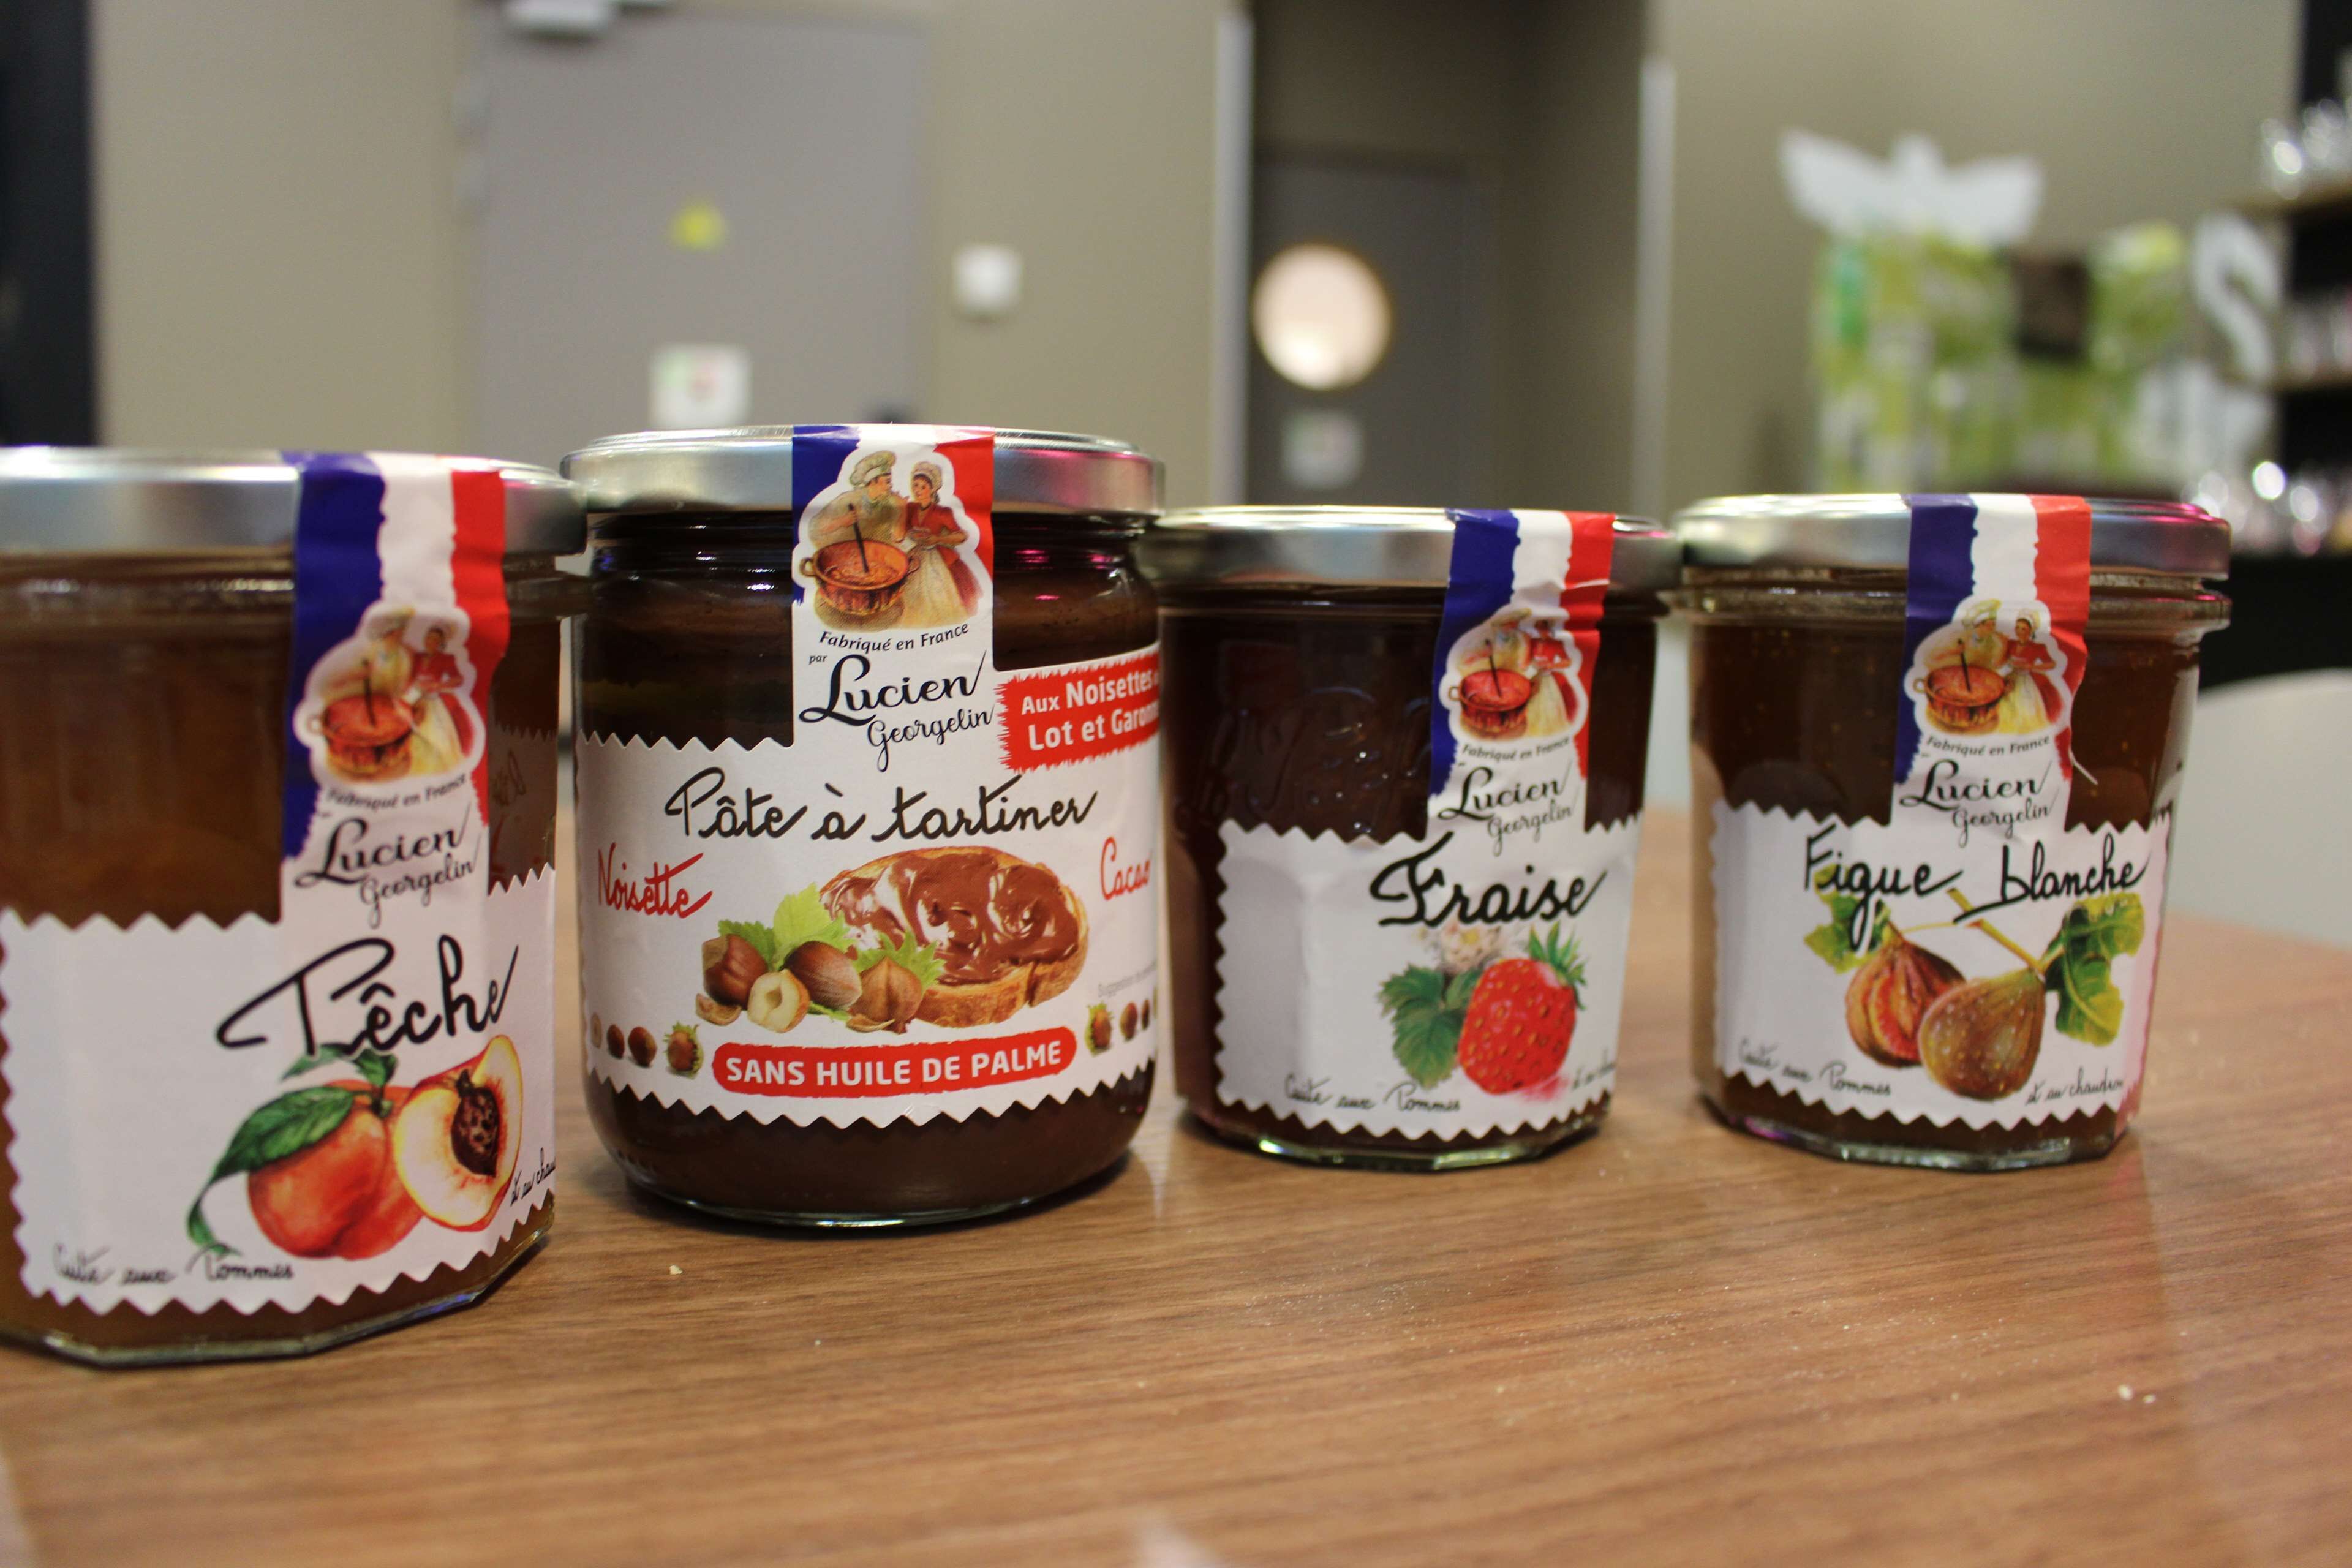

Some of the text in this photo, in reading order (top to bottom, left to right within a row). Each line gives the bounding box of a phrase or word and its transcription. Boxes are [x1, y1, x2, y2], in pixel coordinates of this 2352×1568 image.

[808, 654, 827, 665] par
[819, 623, 969, 654] Fabriqué en France
[798, 649, 987, 726] Lucien
[1021, 696, 1060, 715] Aux
[1065, 669, 1153, 709] Noisettes
[867, 704, 995, 772] Georgelin
[1028, 720, 1074, 752] Lot
[1081, 714, 1106, 742] et
[1926, 736, 2049, 757] Fabriqué en France
[665, 767, 1098, 842] Pâte à tartiner
[1438, 766, 1572, 821] Lucien
[1899, 758, 2052, 812] Lucien
[1952, 787, 2059, 848] Georgelin
[294, 817, 472, 889] Lucien
[1488, 784, 1580, 858] Georgelin
[359, 832, 481, 929] Georgelin
[598, 842, 713, 919] Noisette
[1100, 836, 1153, 900] Cacao
[1370, 831, 1607, 928] Fraise
[1804, 823, 2151, 951] Figue blanche
[216, 935, 518, 1056] Pêche
[726, 1039, 1061, 1087] SANS HUILE DE PALME
